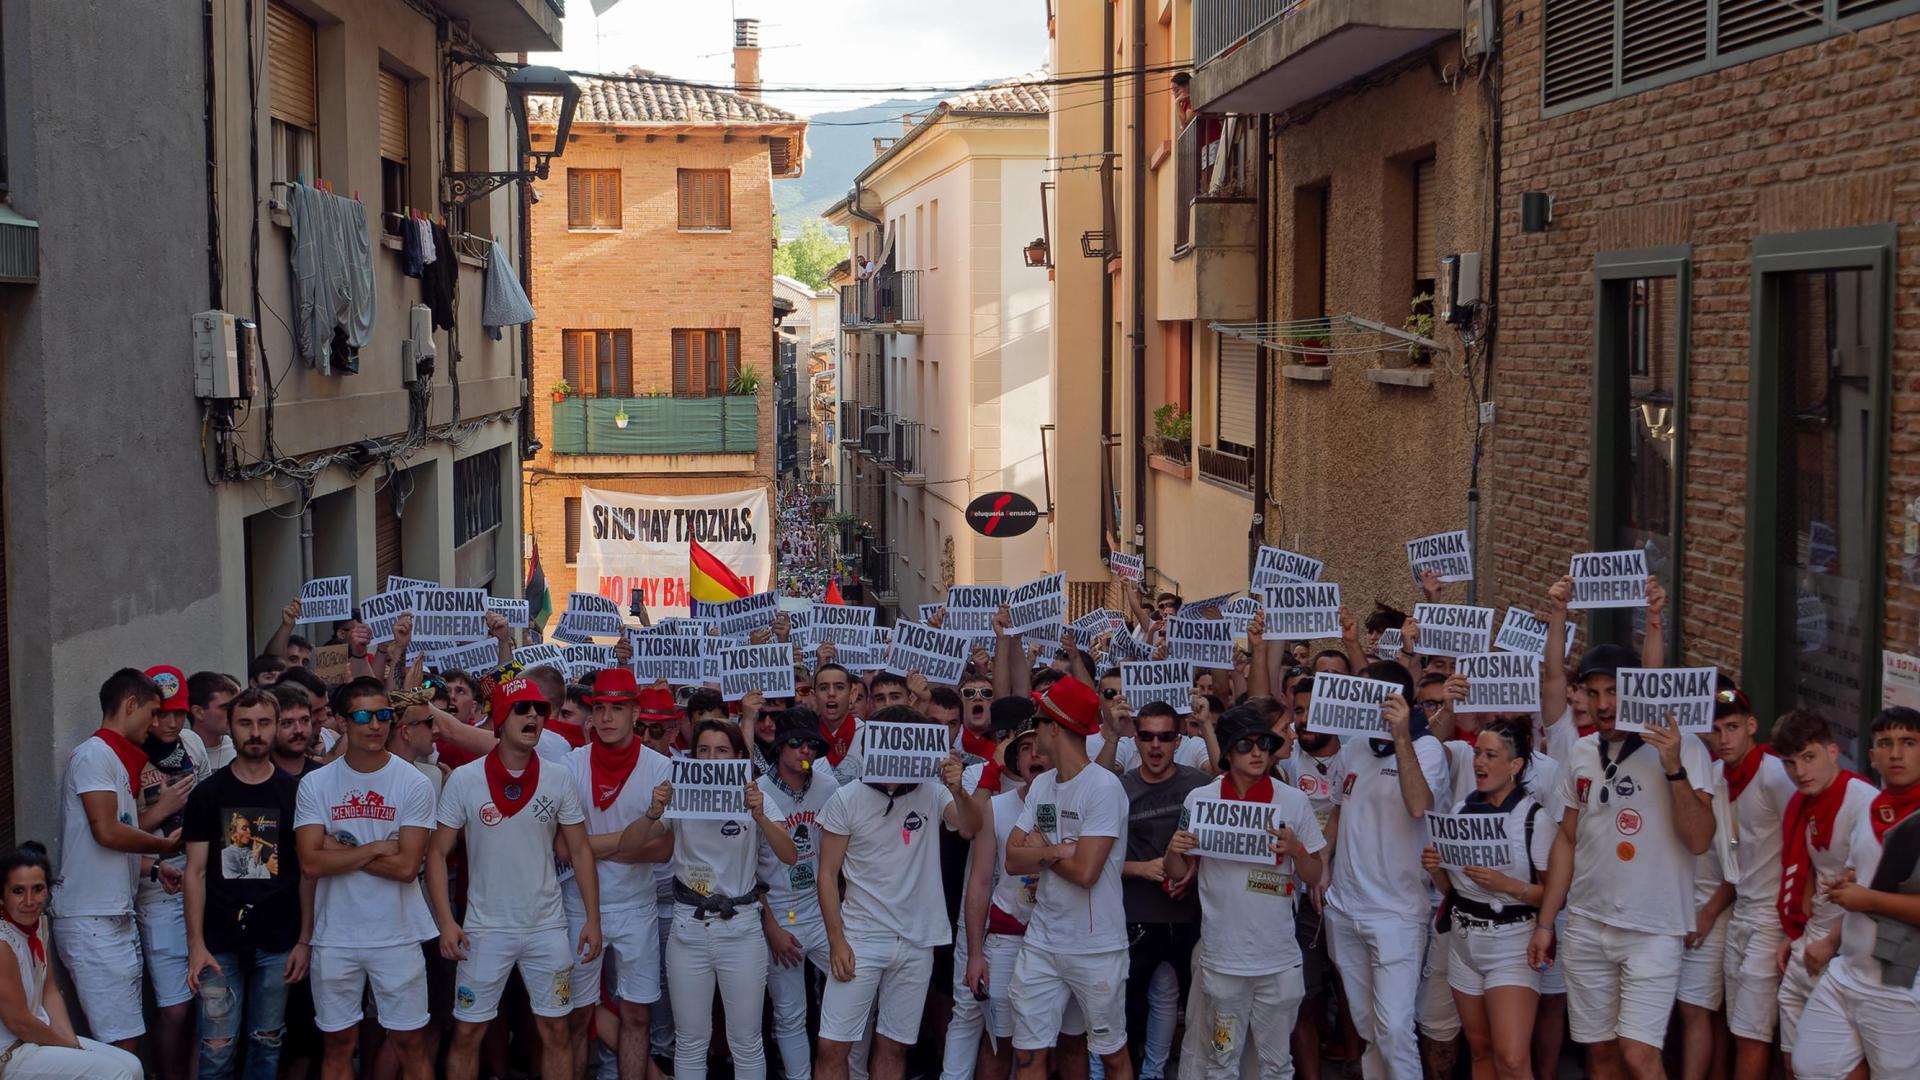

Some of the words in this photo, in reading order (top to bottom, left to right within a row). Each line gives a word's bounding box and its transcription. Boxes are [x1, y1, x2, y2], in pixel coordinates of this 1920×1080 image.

[592, 504, 608, 540] SI
[611, 506, 636, 540] NO
[638, 508, 672, 543] HAY
[674, 506, 757, 545] TXOZNAS,
[1409, 532, 1465, 561] TXOSNAK
[1112, 551, 1141, 568] TXOSNAK
[1260, 549, 1319, 580] TXOSNAK
[1572, 553, 1643, 578] TXOSNAK
[301, 578, 348, 599] TXOSNAK
[600, 575, 623, 607] NO
[626, 575, 660, 607] HAY
[947, 588, 1009, 608] TXOSNAK
[1007, 575, 1062, 605] TXOSNAK
[1264, 586, 1338, 609] TXOSNAK
[1570, 579, 1648, 602] AURRERA!
[299, 598, 349, 620] URRERA!
[361, 591, 413, 619] TXOSNA
[415, 591, 485, 612] TXOSNAK
[488, 599, 526, 608] OSNAK
[719, 592, 777, 618] TXOSNAK
[1008, 595, 1062, 628] URRERA!
[413, 615, 485, 636] AURRERA!
[568, 613, 624, 633] AURRERA
[813, 605, 871, 628] TXOSNAK
[942, 611, 994, 631] AURRE
[1263, 610, 1340, 633] AURRERA!
[1418, 606, 1489, 630] TXOSNAK
[1508, 610, 1571, 643] TXOSK
[810, 627, 869, 648] AURRERA!
[897, 624, 968, 660] TXOSNAK
[1170, 619, 1232, 642] TXOSNAK
[1415, 628, 1487, 653] URRERA!
[1501, 628, 1545, 656] AURRE
[514, 644, 559, 666] OSNAK
[560, 645, 606, 665] XOSNAK
[636, 638, 701, 657] TXOSNAK
[720, 644, 791, 671] TXOSNAK
[1167, 641, 1233, 664] AURRERA!
[636, 659, 701, 680] AURRERA!
[888, 651, 962, 681] AURRERA!
[1123, 661, 1191, 686] TXOSNAK
[1458, 654, 1535, 679] TXOSNAK
[722, 671, 792, 702] AURRERA!
[1318, 676, 1398, 704] TXOSNAK
[1620, 671, 1711, 699] TXOSNAK
[1619, 700, 1709, 727] AURRERA!
[869, 725, 946, 752] TXOSNAK
[672, 760, 748, 786] TXOSNAK
[865, 753, 947, 778] AURRERA
[668, 788, 750, 814] AURRERA
[1195, 801, 1275, 829] TXOSNAK
[1427, 814, 1508, 841] TXOSNAK
